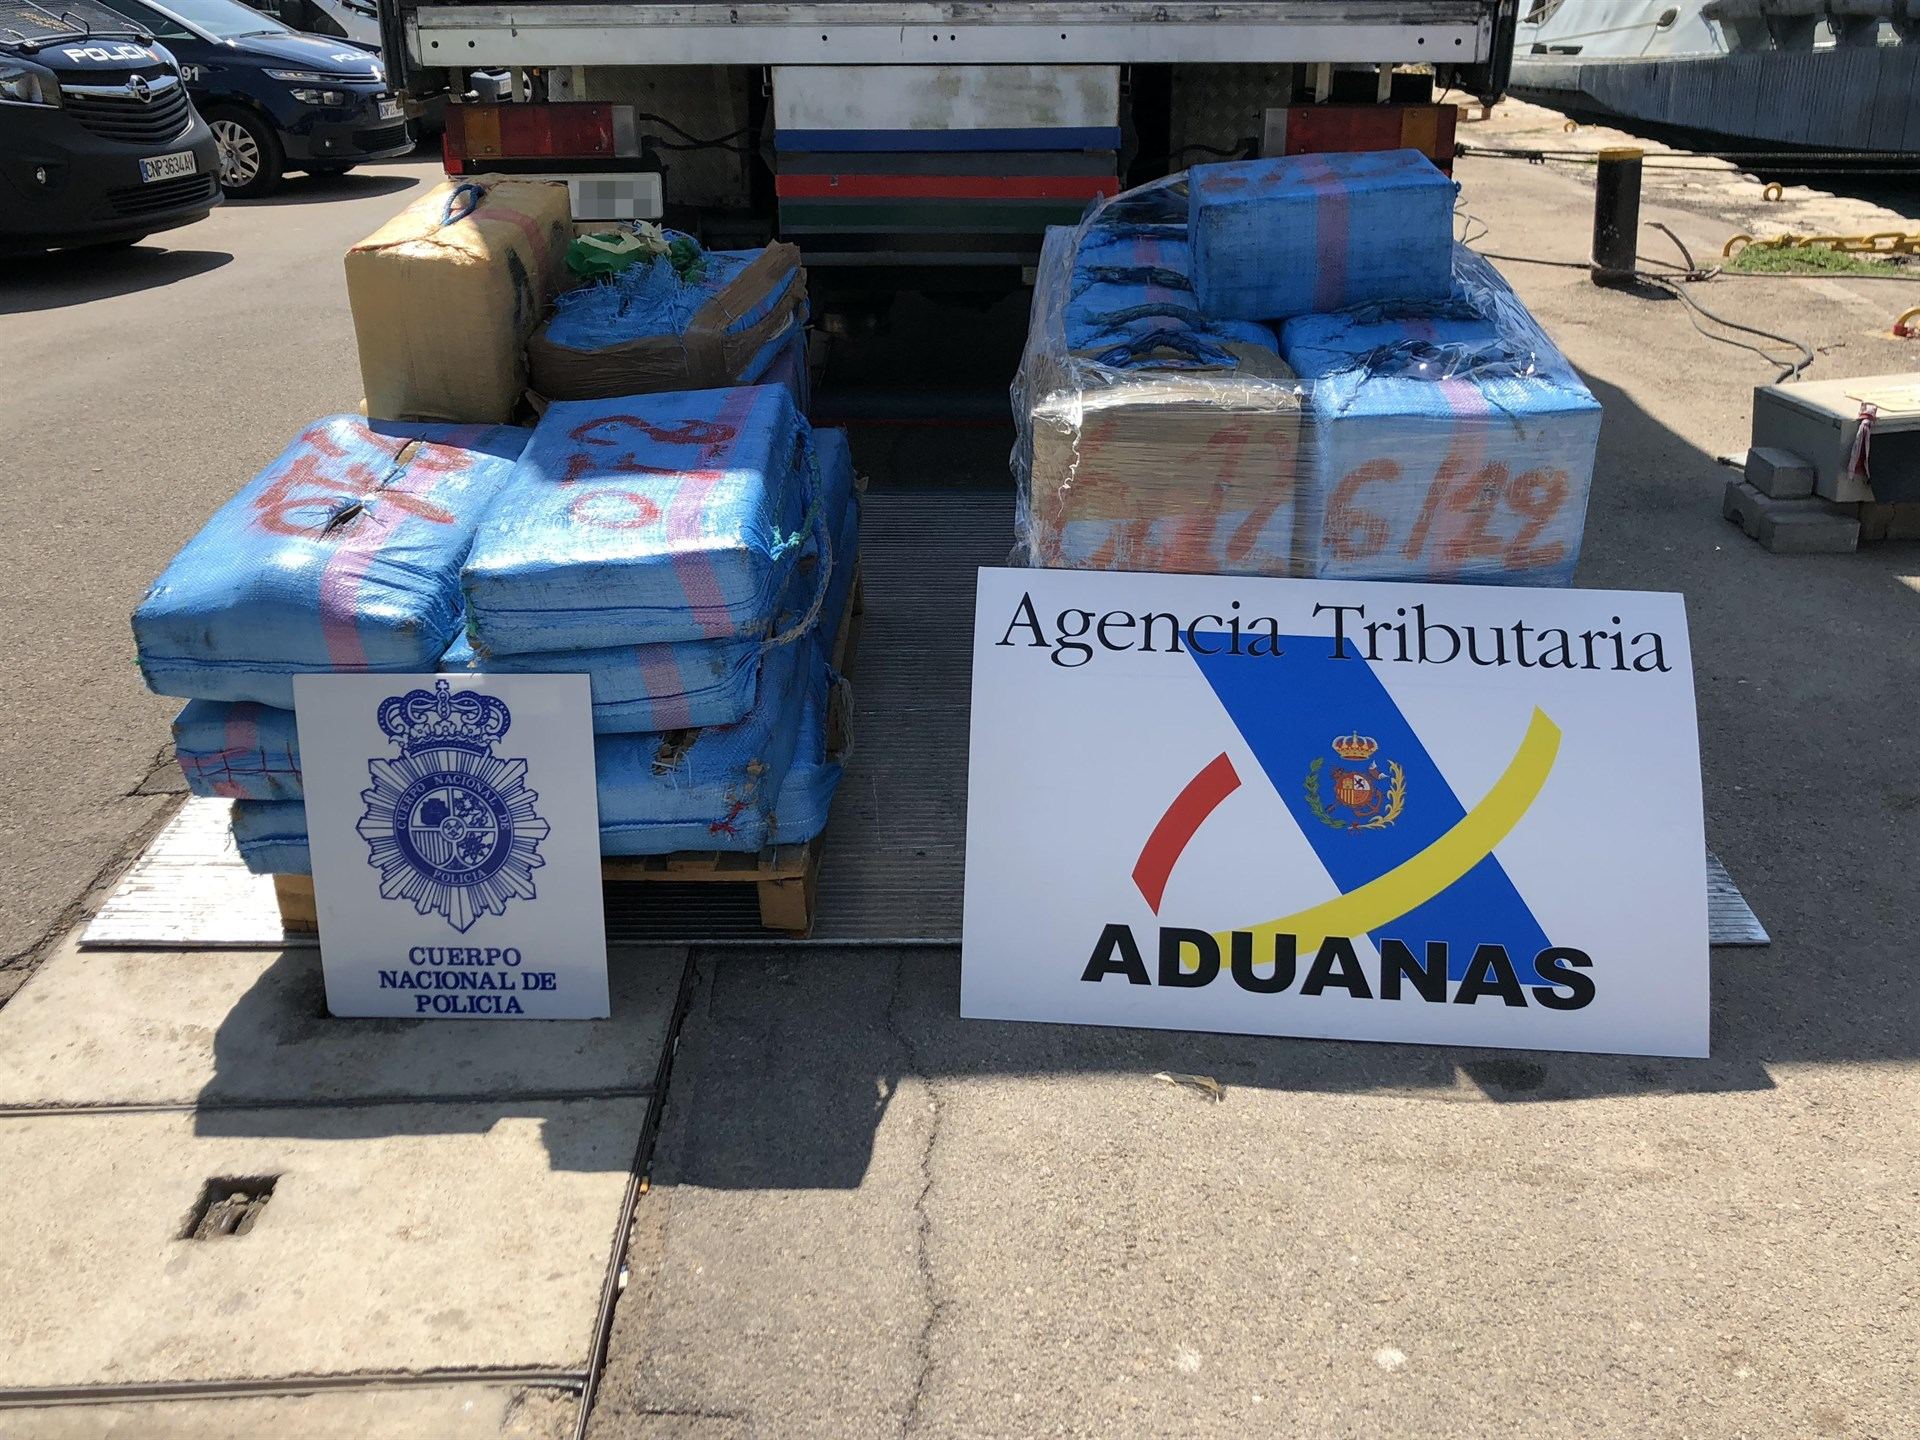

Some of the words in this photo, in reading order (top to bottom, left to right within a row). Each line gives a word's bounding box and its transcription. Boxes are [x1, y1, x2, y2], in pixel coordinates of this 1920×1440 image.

[996, 592, 1281, 666] Agencia
[1313, 603, 1671, 672] Tributaria
[397, 782, 426, 830] CUERPO
[434, 774, 497, 806] NACIONAL
[498, 813, 510, 830] DE
[433, 869, 487, 883] POLICIA
[409, 947, 520, 966] CUERPO
[1081, 924, 1595, 1010] ADUANAS
[379, 970, 515, 990] NACIONAL
[523, 973, 556, 990] DE
[416, 995, 524, 1014] POLICIA
